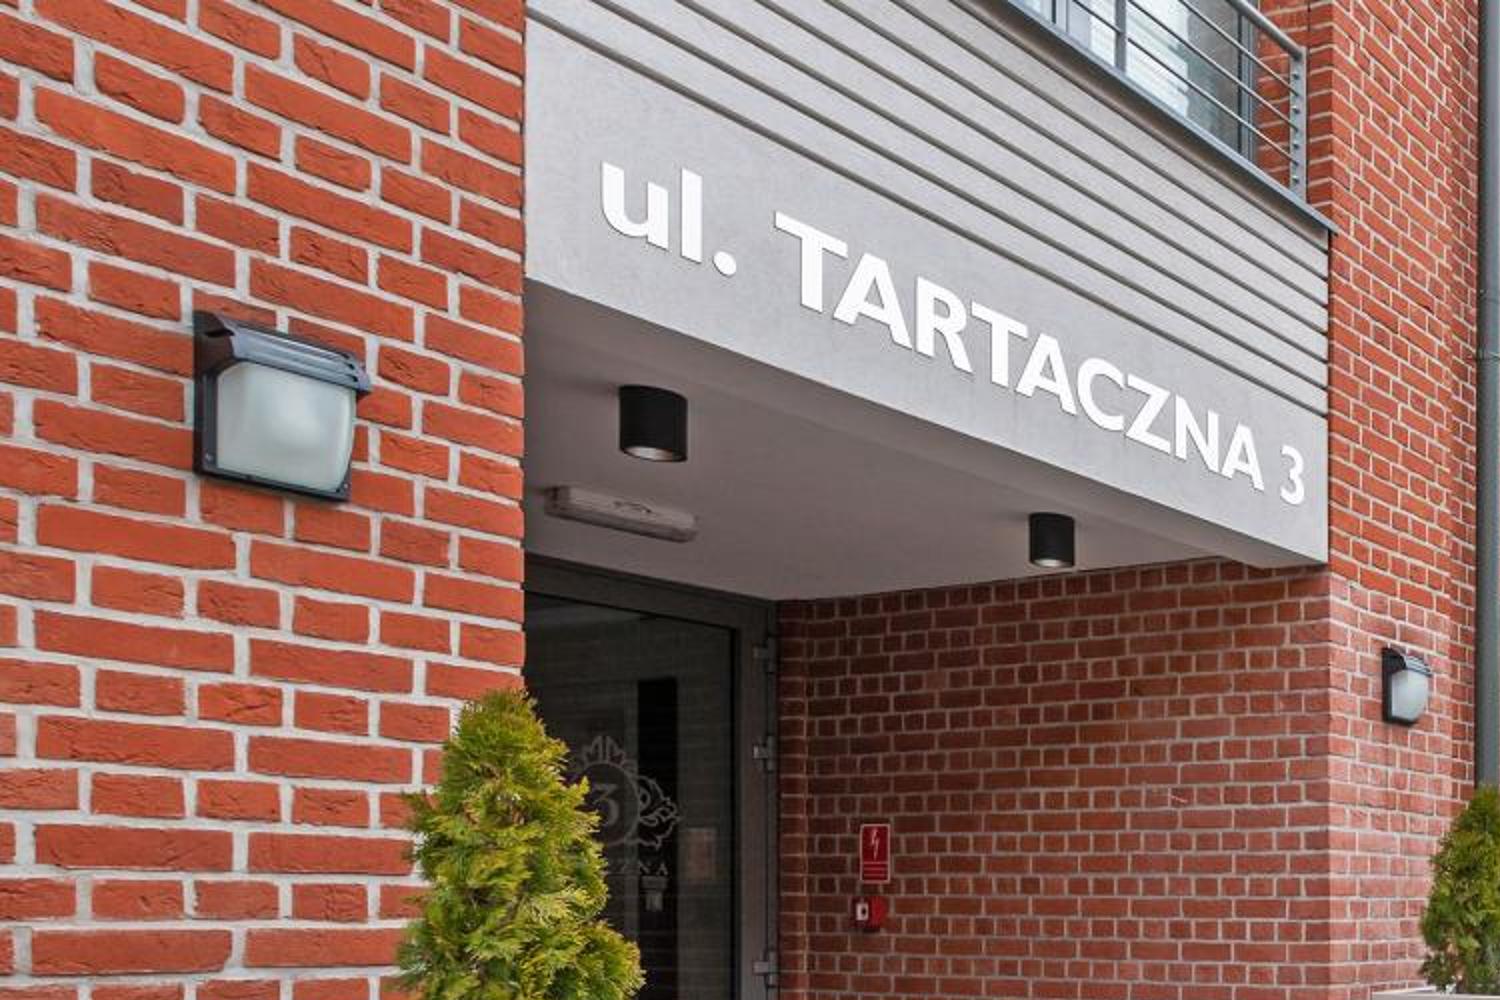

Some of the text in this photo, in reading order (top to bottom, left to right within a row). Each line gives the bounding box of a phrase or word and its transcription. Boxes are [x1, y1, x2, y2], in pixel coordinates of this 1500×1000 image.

[601, 161, 1306, 505] ul. TARTACZNA 3
